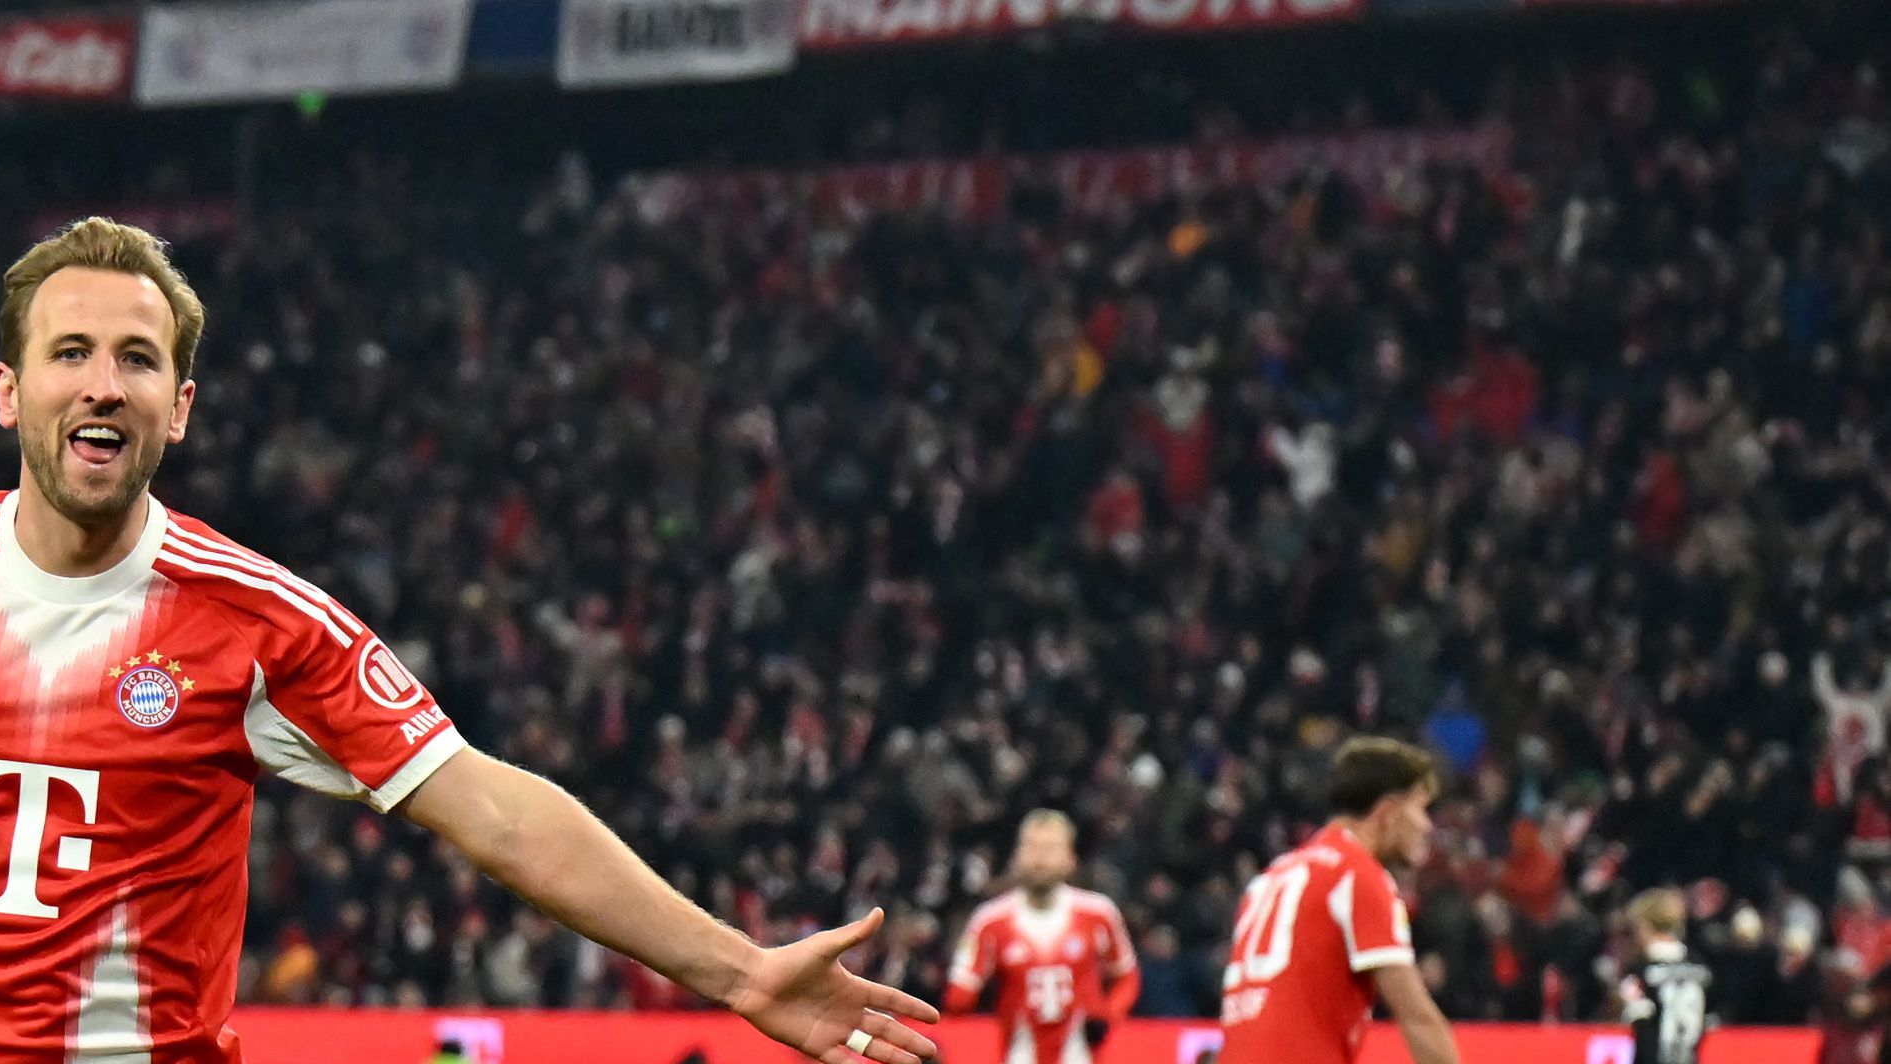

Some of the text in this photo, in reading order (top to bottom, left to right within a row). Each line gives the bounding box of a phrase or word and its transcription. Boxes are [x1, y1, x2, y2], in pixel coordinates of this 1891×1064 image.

[124, 671, 175, 698] FC BAYERN
[1221, 861, 1310, 992] 20
